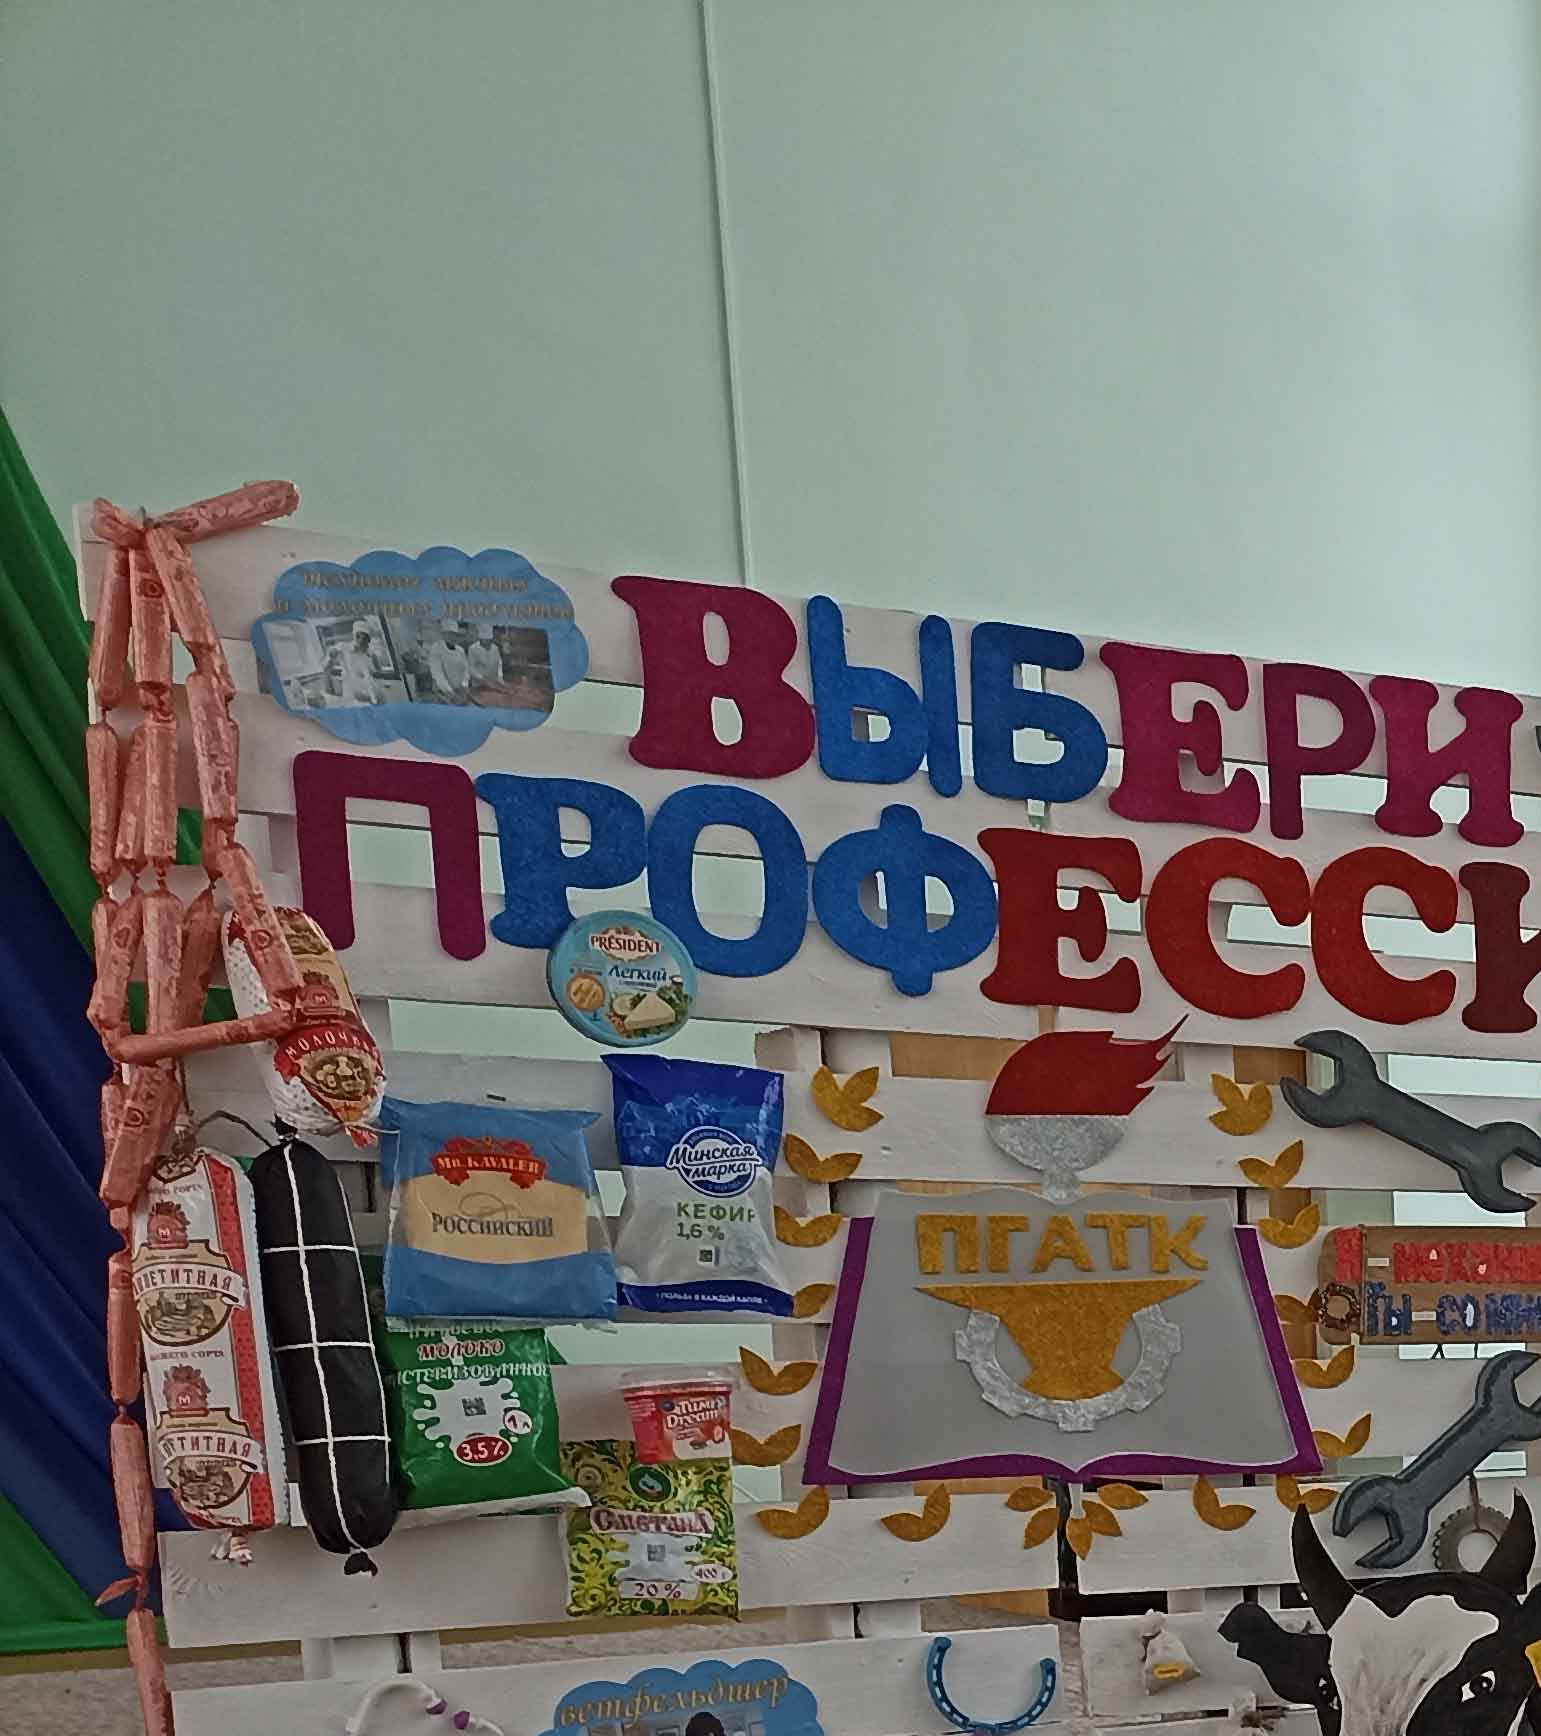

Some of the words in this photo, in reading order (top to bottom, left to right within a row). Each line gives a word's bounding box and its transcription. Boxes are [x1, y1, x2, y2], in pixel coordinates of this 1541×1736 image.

[611, 575, 1524, 847] ВЫБЕРИ
[467, 1156, 539, 1173] KAVALER
[669, 1145, 754, 1165] Минская
[692, 1163, 747, 1180] марка
[677, 1202, 756, 1222] КЕФИР
[432, 1213, 553, 1237] РОССИЙСКИЙ
[916, 1212, 1208, 1274] ПГАТК
[419, 1341, 504, 1360] МОЛОКО
[634, 1582, 658, 1597] 20
[664, 1583, 681, 1599] %
